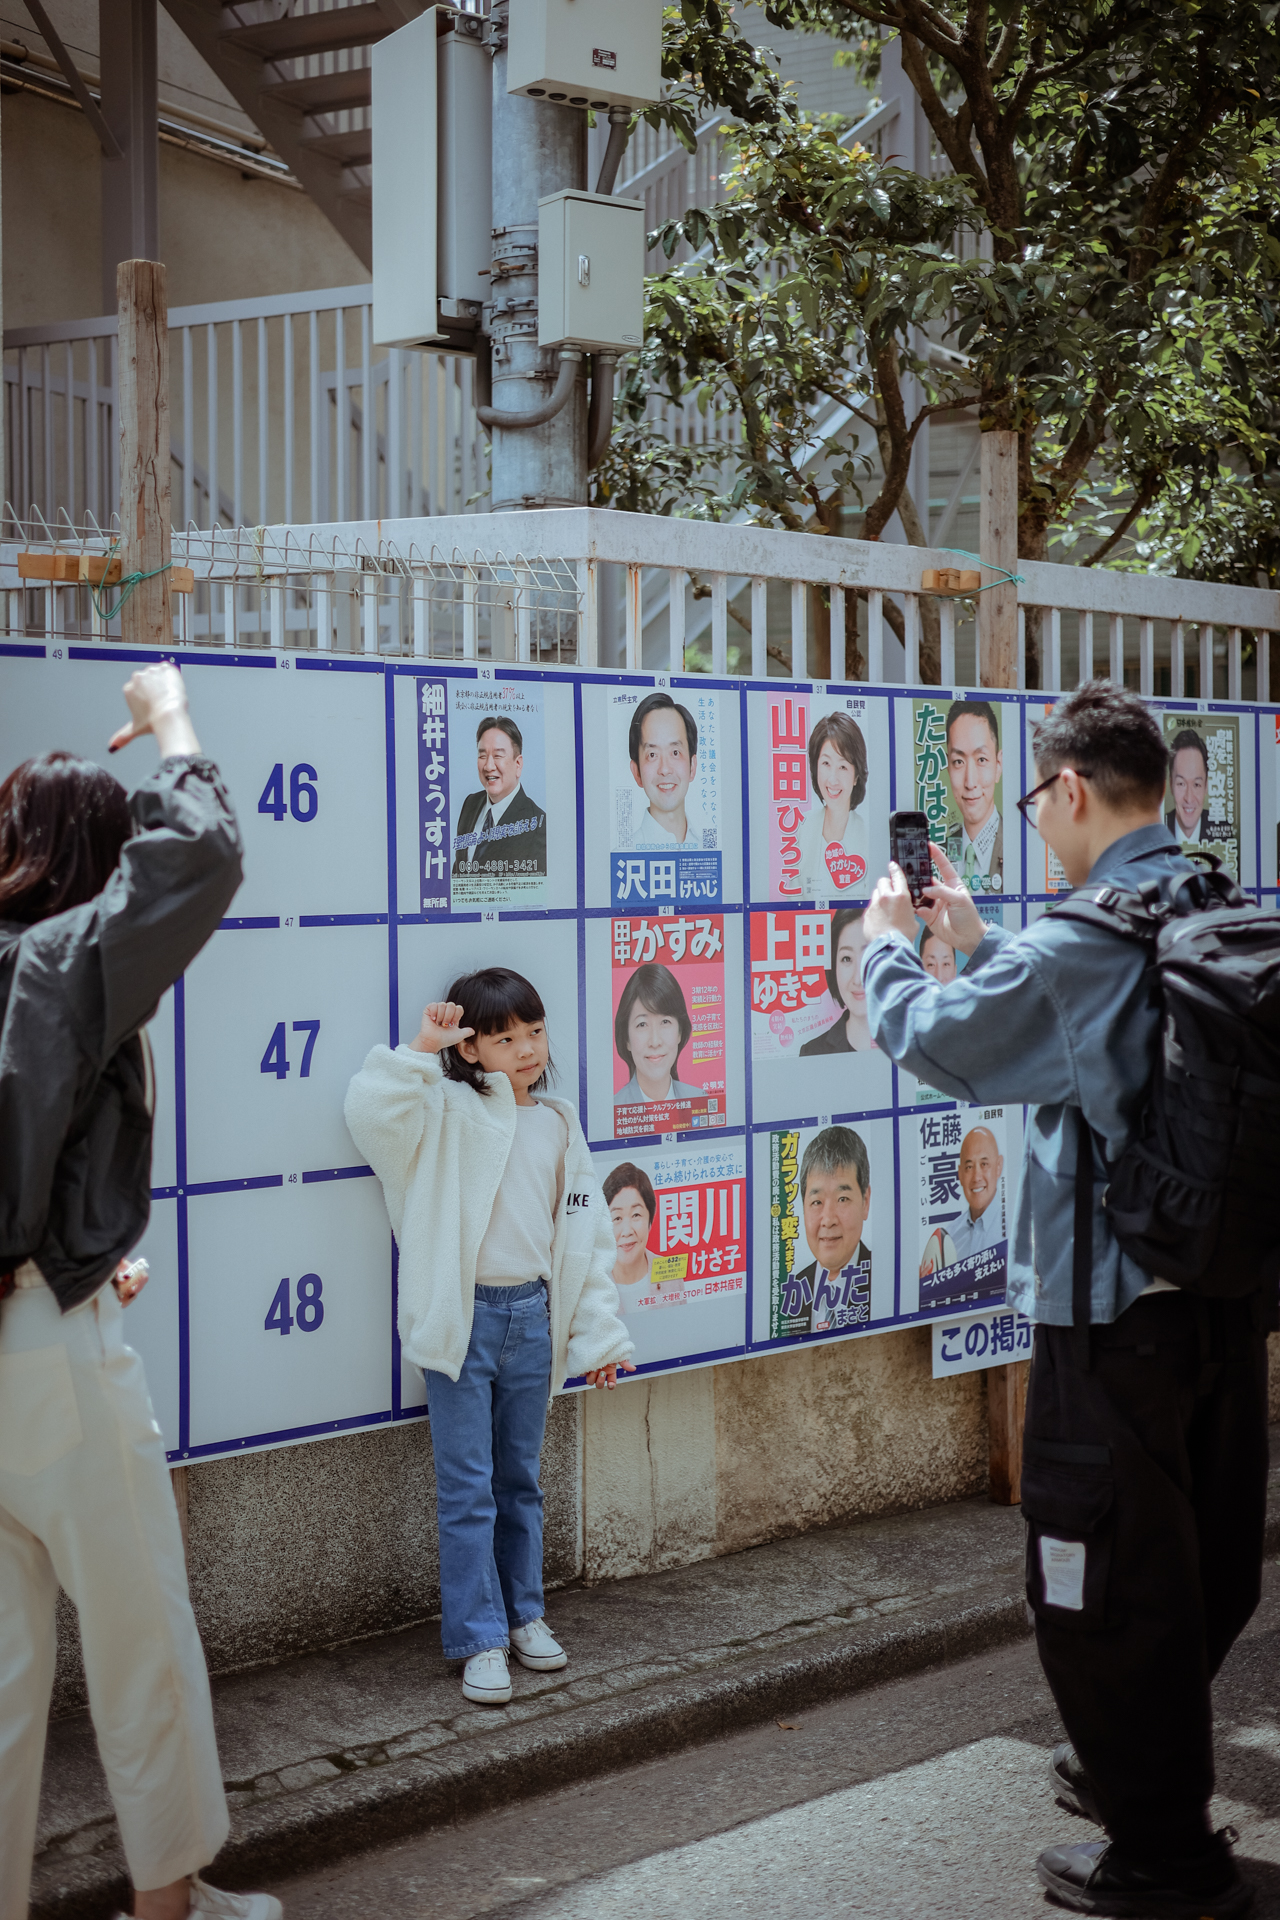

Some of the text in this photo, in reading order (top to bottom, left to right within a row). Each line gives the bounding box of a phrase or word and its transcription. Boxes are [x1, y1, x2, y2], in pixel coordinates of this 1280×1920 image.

[52, 649, 63, 660] 49
[280, 659, 290, 670] 46
[482, 669, 490, 679] 43
[658, 678, 666, 687] 40
[846, 700, 866, 710] 自民党
[257, 762, 319, 823] 46
[421, 683, 447, 880] 細井ようすけ
[771, 699, 807, 896] 山田ひろこ
[616, 859, 676, 900] 沢田
[680, 880, 718, 899] けいじ
[423, 897, 448, 908] 無所属
[662, 906, 670, 914] 41
[818, 901, 826, 909] 38
[284, 917, 294, 927] 47
[485, 912, 494, 920] 44
[614, 918, 723, 965] 田中 かすみ
[751, 912, 832, 973] 上田
[753, 972, 821, 1010] ゆきこ
[260, 1019, 321, 1080] 47
[702, 1080, 725, 1090] 公明党
[984, 1108, 1004, 1120] 自民党
[665, 1133, 673, 1142] 42
[919, 1113, 963, 1149] 佐藤
[288, 1173, 298, 1184] 48
[654, 1164, 743, 1186] 住み続けられる文京に
[567, 1192, 590, 1207] IKE
[920, 1154, 928, 1226] ごういち
[928, 1151, 962, 1225] 豪一
[781, 1132, 800, 1273] ガラッと変えます
[658, 1184, 741, 1253] 関川
[691, 1244, 742, 1275] けさ子
[922, 1247, 997, 1287] 一人でも多く寄り添い
[974, 1258, 1005, 1282] 支えたい
[705, 1277, 743, 1295] 日本共産党
[781, 1260, 871, 1317] かんだ
[264, 1273, 325, 1336] 48
[836, 1304, 869, 1326] まさと
[940, 1313, 1034, 1363] この掲示
